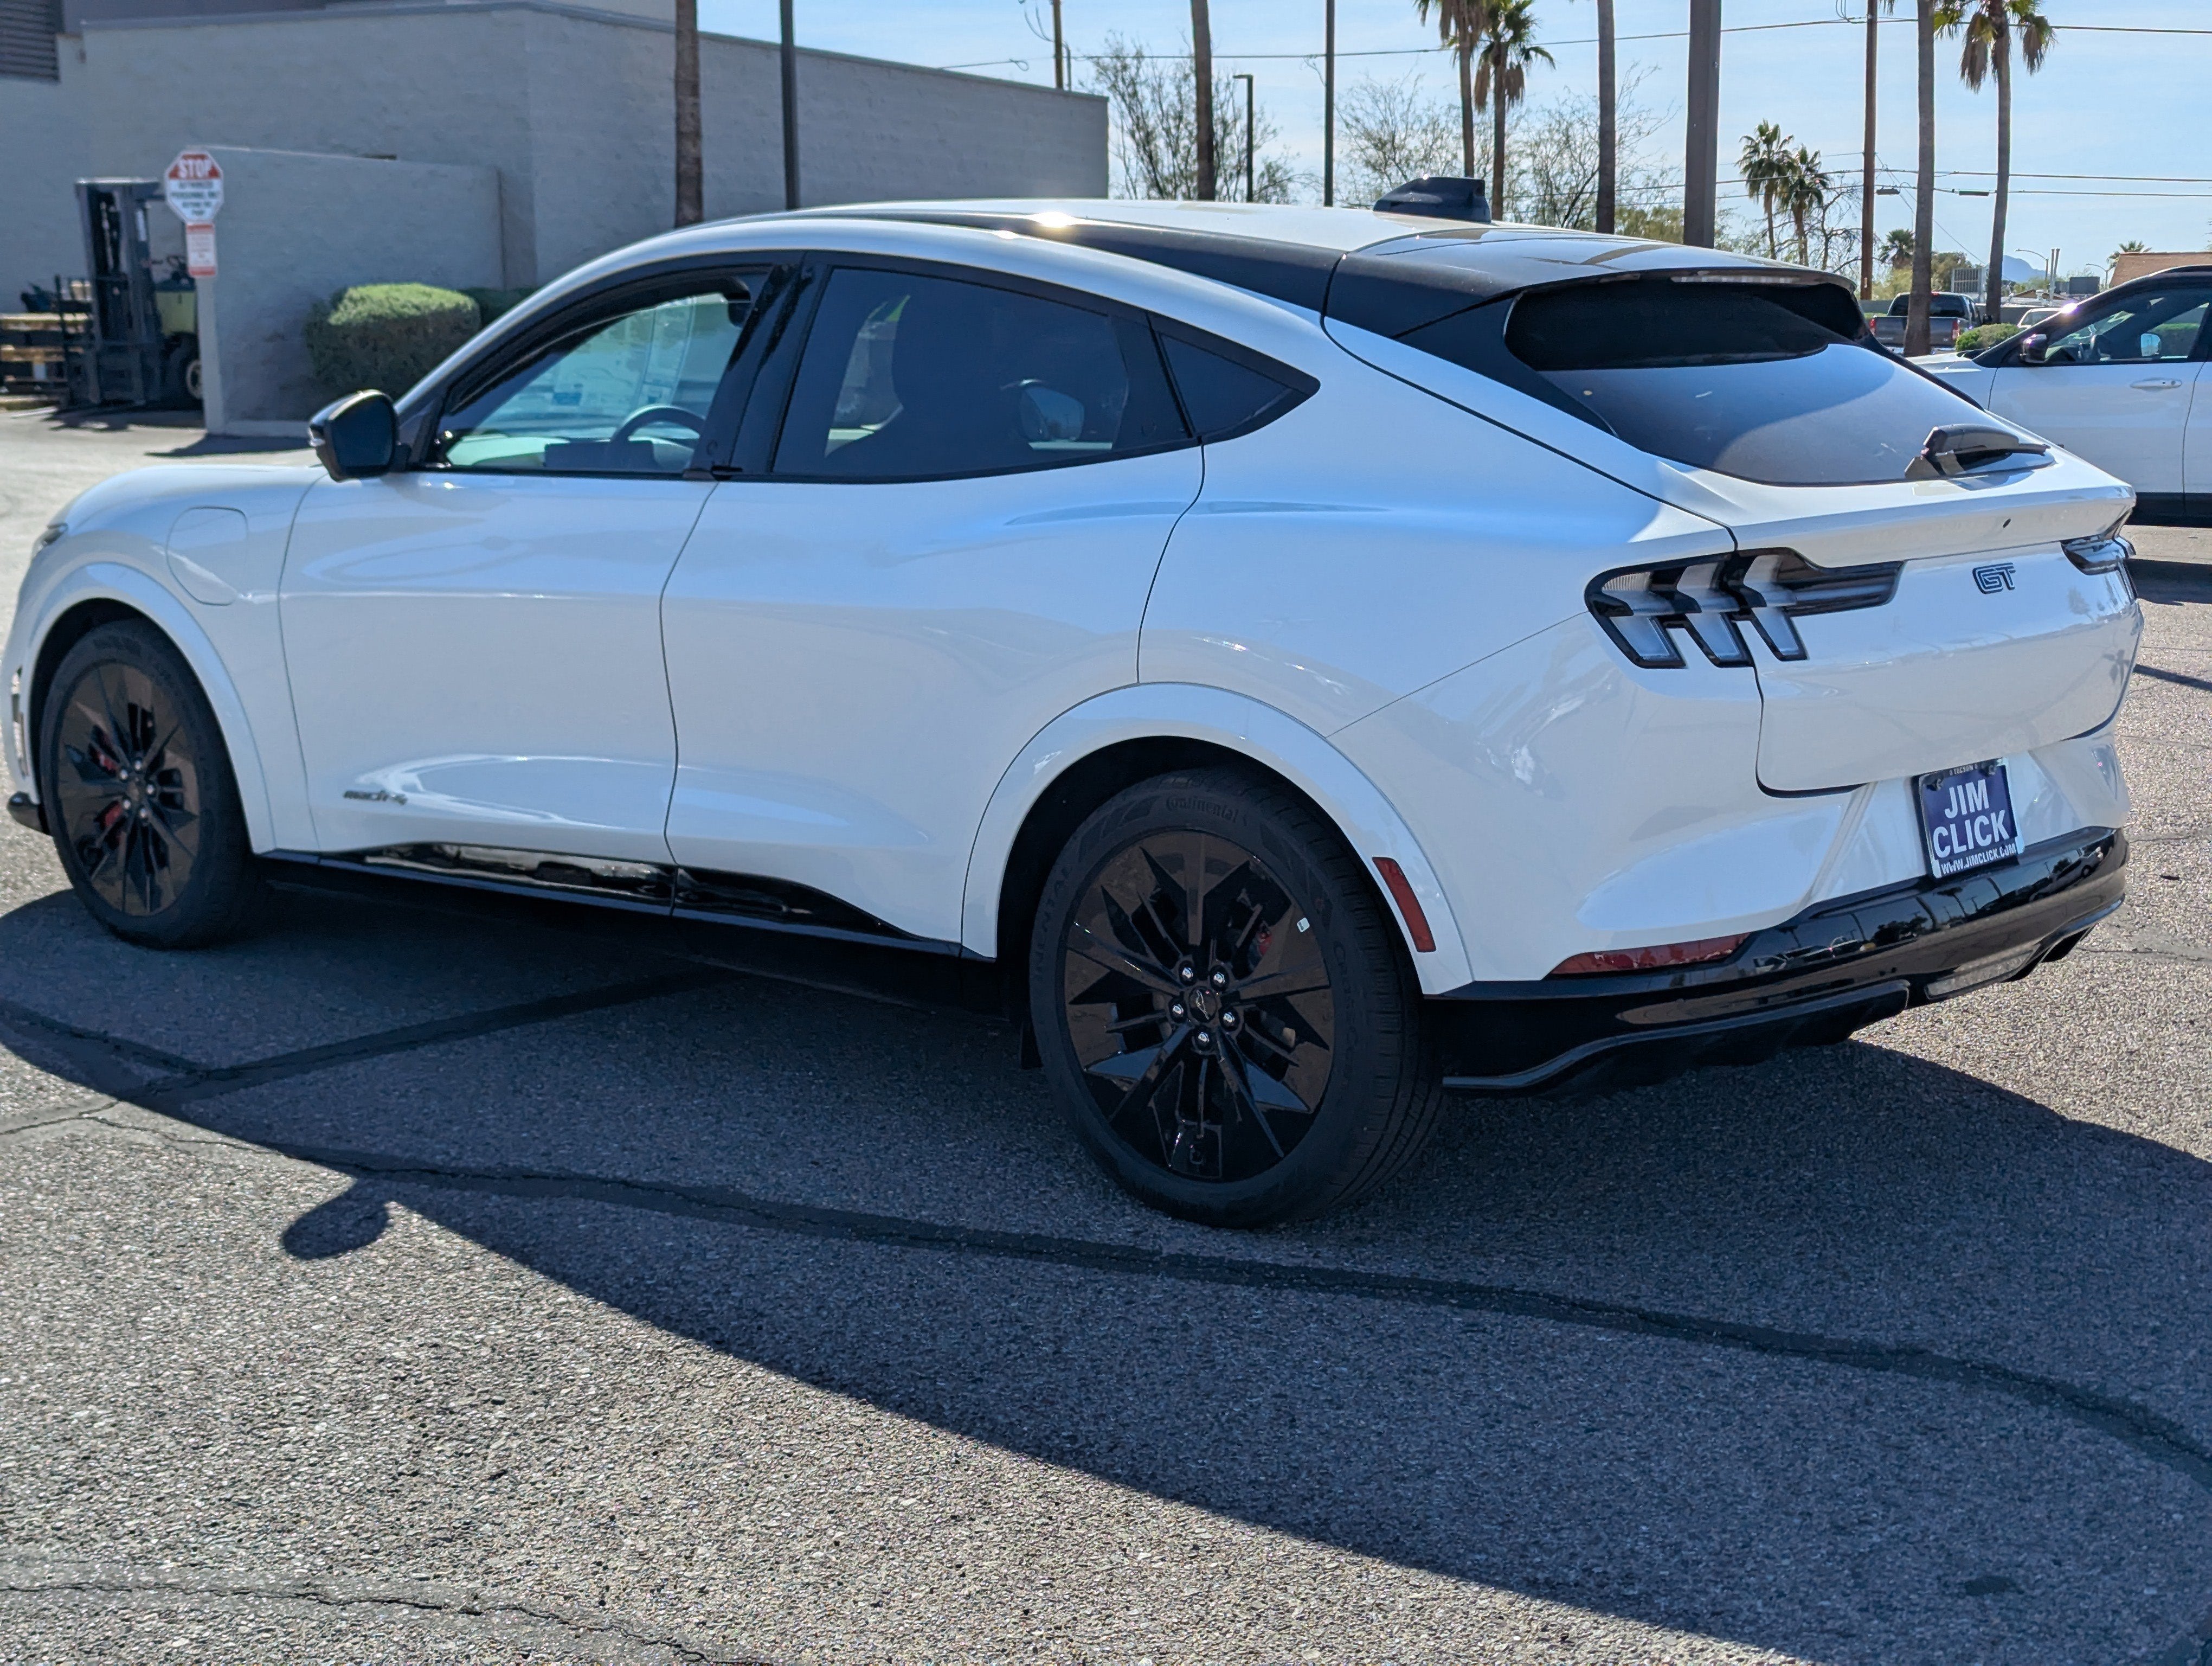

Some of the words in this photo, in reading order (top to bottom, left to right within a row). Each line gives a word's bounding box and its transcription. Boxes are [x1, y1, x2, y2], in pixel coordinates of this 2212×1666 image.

[179, 159, 211, 178] STOP
[1972, 562, 2016, 594] GT
[1944, 779, 1989, 818] JIM
[1933, 810, 2010, 858] CLICK
[1941, 843, 2017, 875] WWW.JIMCLICK.COM
